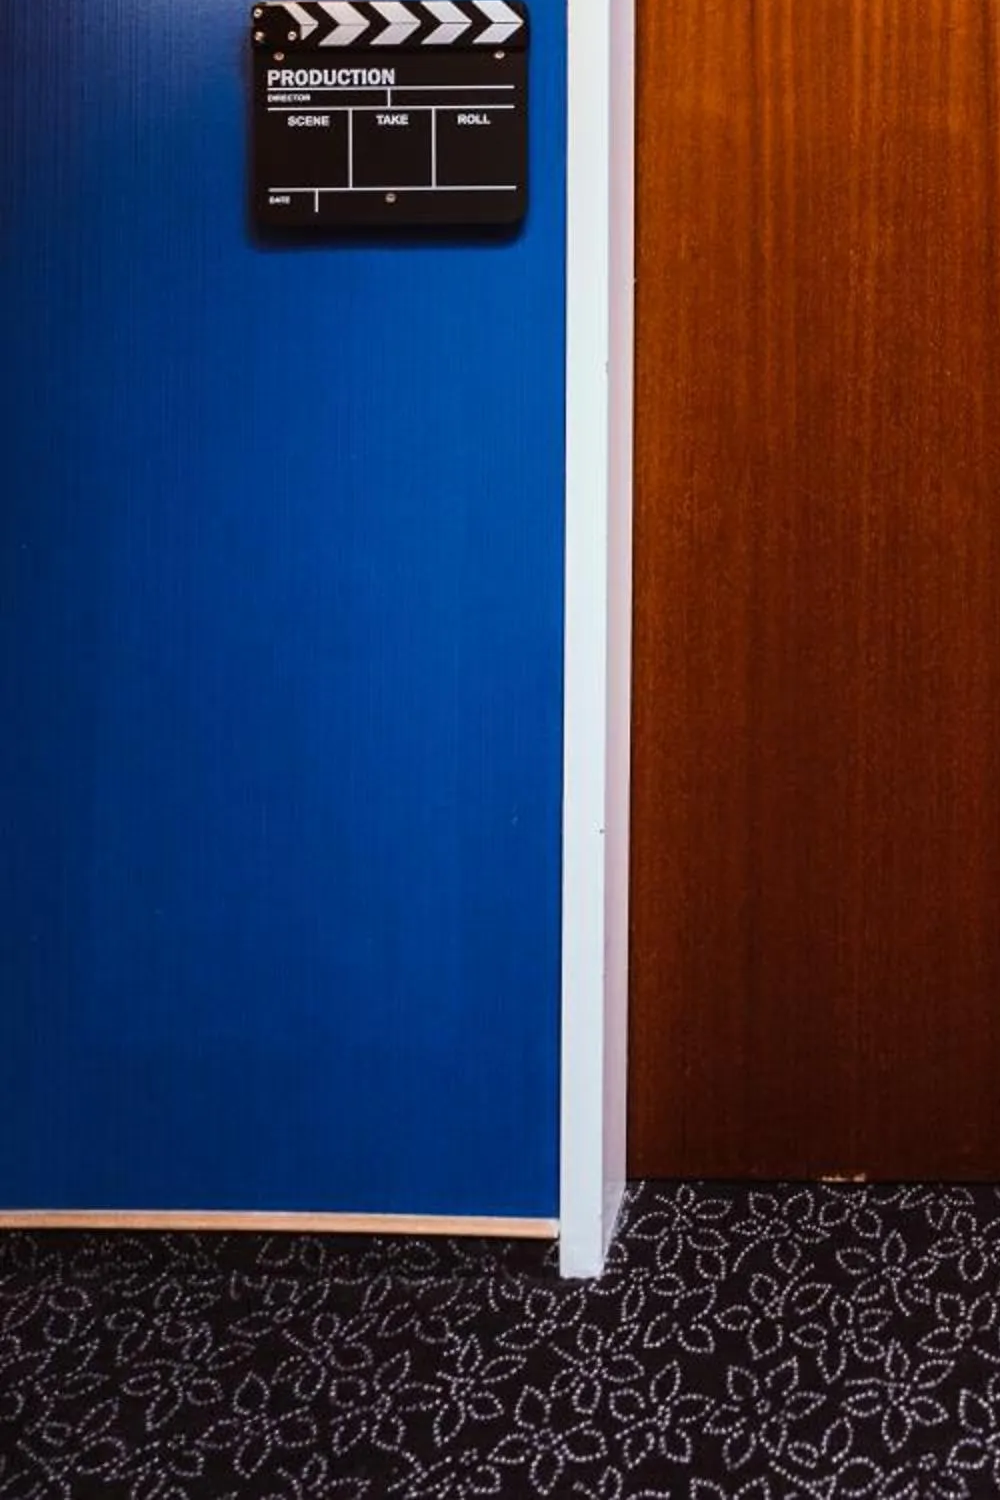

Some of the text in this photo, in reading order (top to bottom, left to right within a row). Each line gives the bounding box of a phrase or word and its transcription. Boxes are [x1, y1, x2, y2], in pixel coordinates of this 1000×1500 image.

[267, 67, 396, 86] PRODUCTION
[267, 93, 311, 103] DIRECTOR
[287, 113, 491, 127] SCENE TAKE ROLL
[268, 195, 291, 205] DATE
